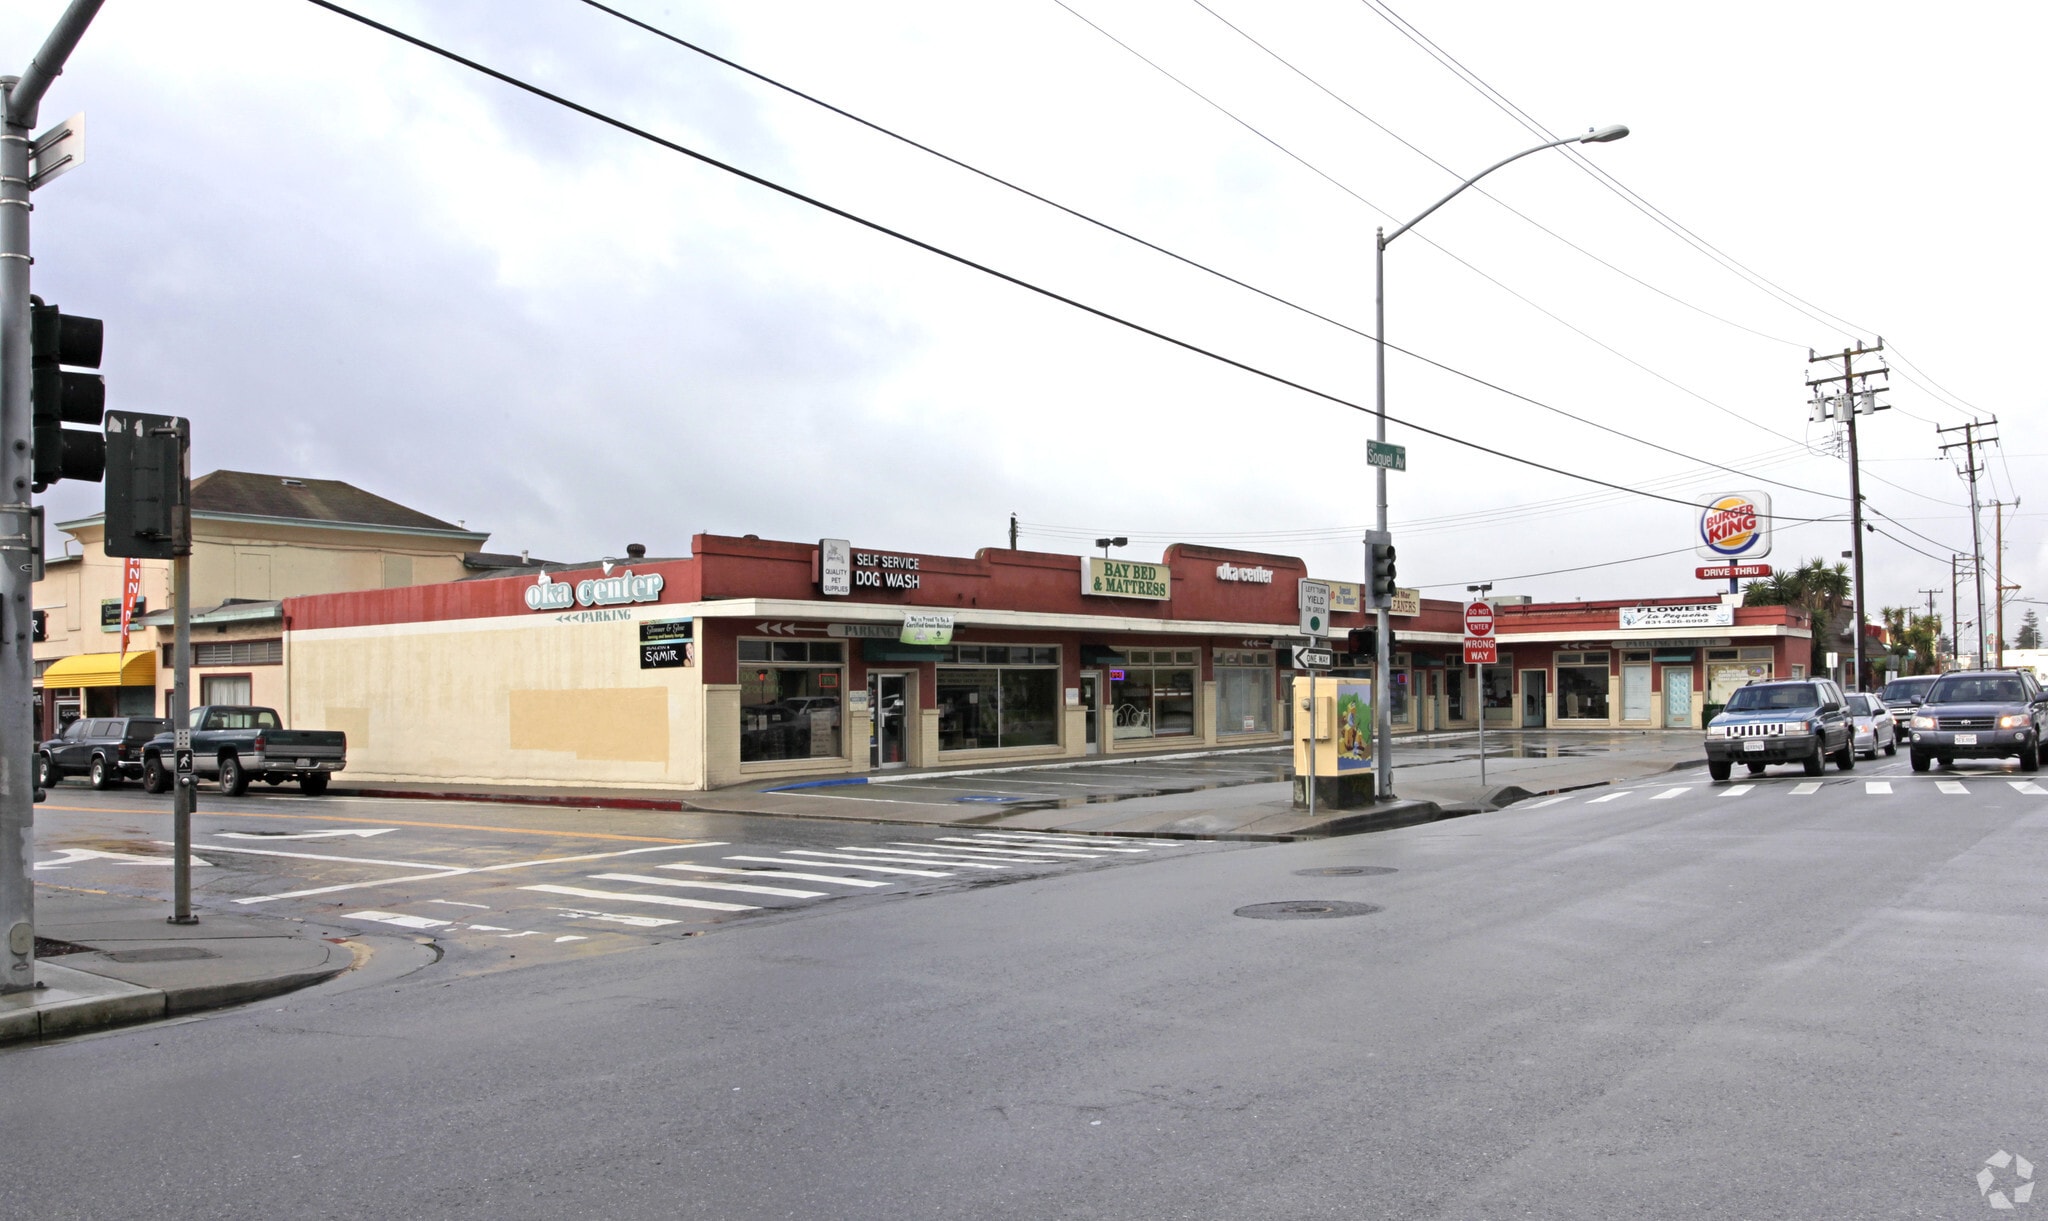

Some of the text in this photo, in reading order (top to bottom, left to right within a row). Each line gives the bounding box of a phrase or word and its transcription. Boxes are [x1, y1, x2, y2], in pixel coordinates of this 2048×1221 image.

[1368, 448, 1404, 468] Soquel Av
[1706, 504, 1755, 529] BURGER
[1708, 515, 1757, 544] KING
[856, 553, 879, 566] SELF
[881, 555, 920, 570] SERVICE
[825, 568, 847, 576] QUALITY
[1104, 561, 1156, 580] BAY BED
[1216, 562, 1274, 583] oka center
[1703, 566, 1759, 577] DRIVE THRU
[856, 570, 920, 589] DOG WASH
[1093, 576, 1166, 597] & MATTRESS
[525, 570, 663, 609] oka center
[824, 585, 848, 593] SUPPLIES
[1307, 595, 1325, 605] YIELD
[1391, 599, 1417, 613] EANERS
[1637, 604, 1718, 613] FLOWERS
[581, 609, 631, 623] PARKING
[844, 625, 895, 636] PARKING
[1465, 640, 1495, 649] WRONG
[645, 650, 679, 667] SAMIR
[1306, 654, 1317, 662] ONE
[1470, 651, 1489, 660] WAY
